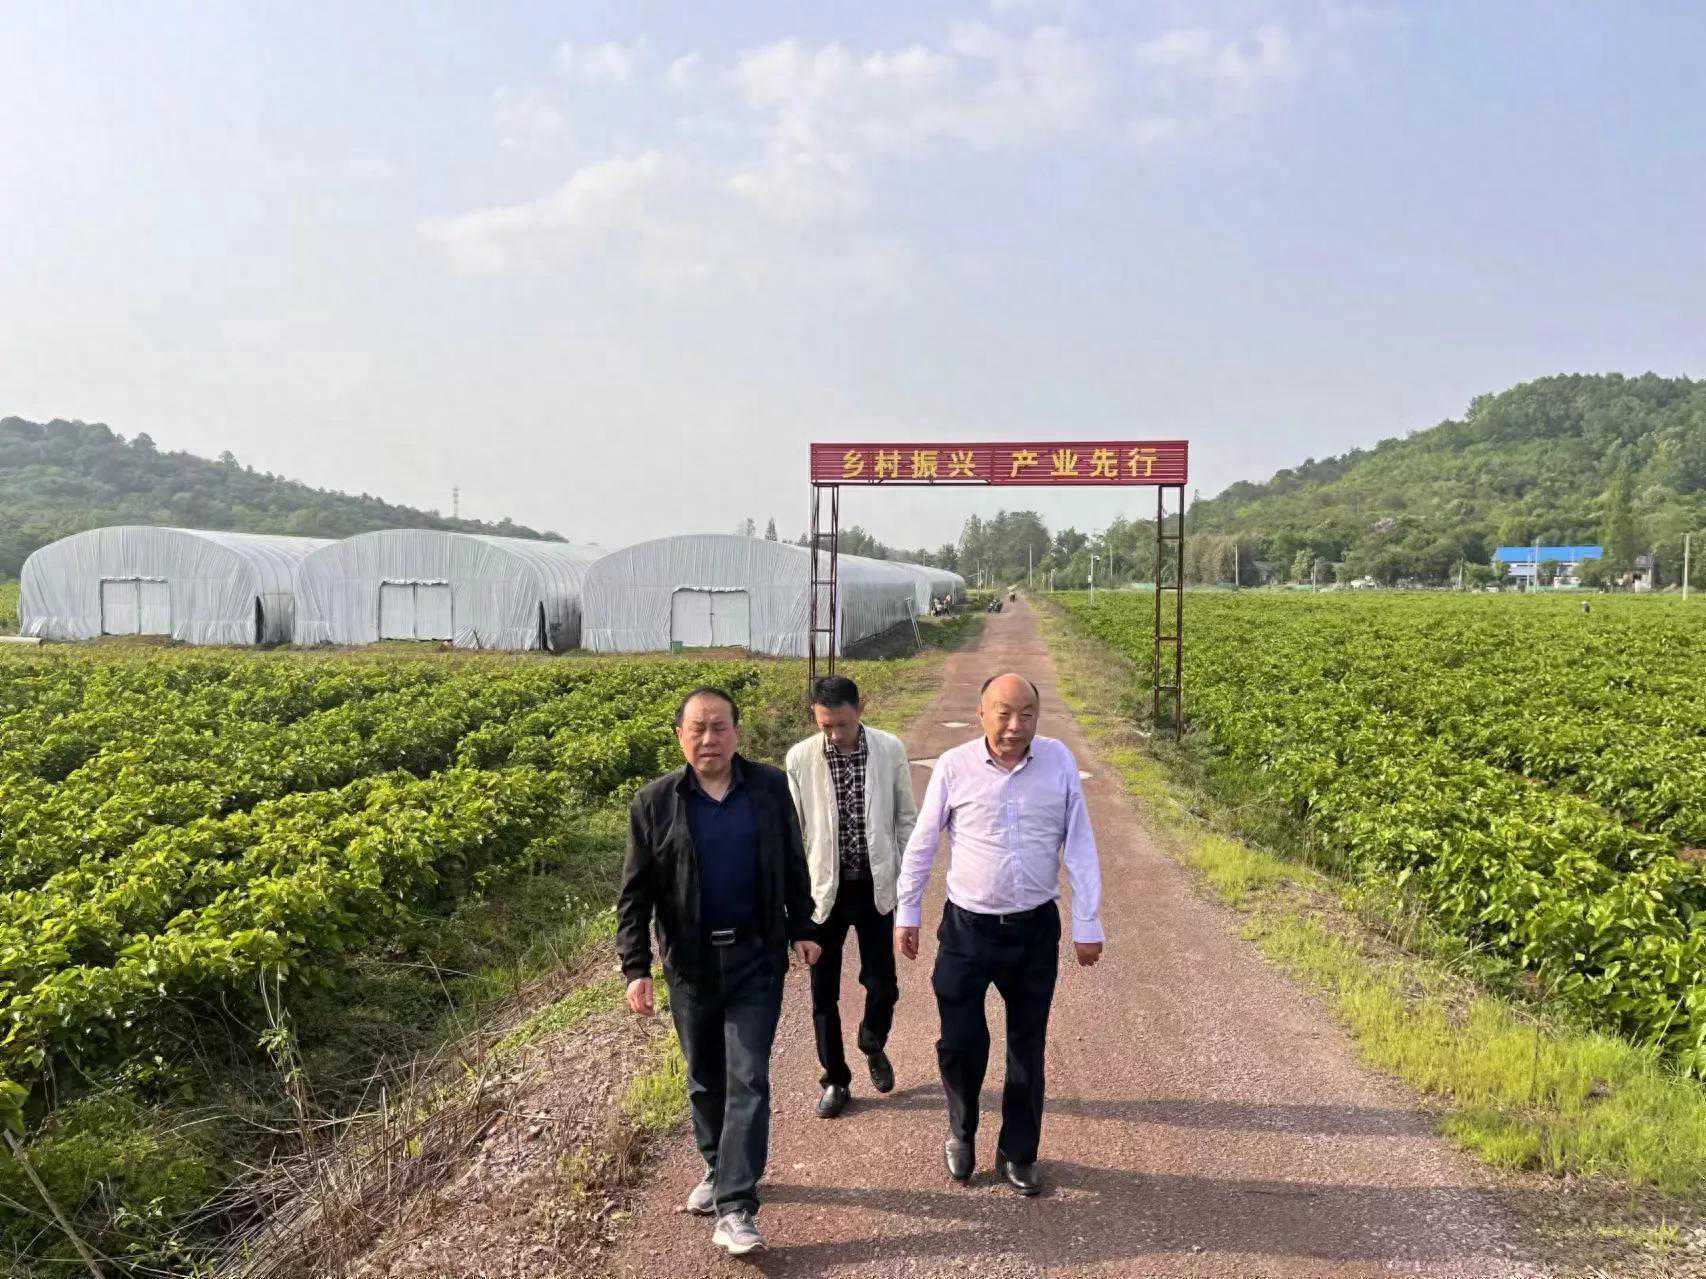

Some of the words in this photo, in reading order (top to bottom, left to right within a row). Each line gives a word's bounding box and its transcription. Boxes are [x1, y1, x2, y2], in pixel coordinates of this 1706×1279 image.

[841, 450, 975, 478] 乡村振兴
[1010, 448, 1157, 478] 产业先行
